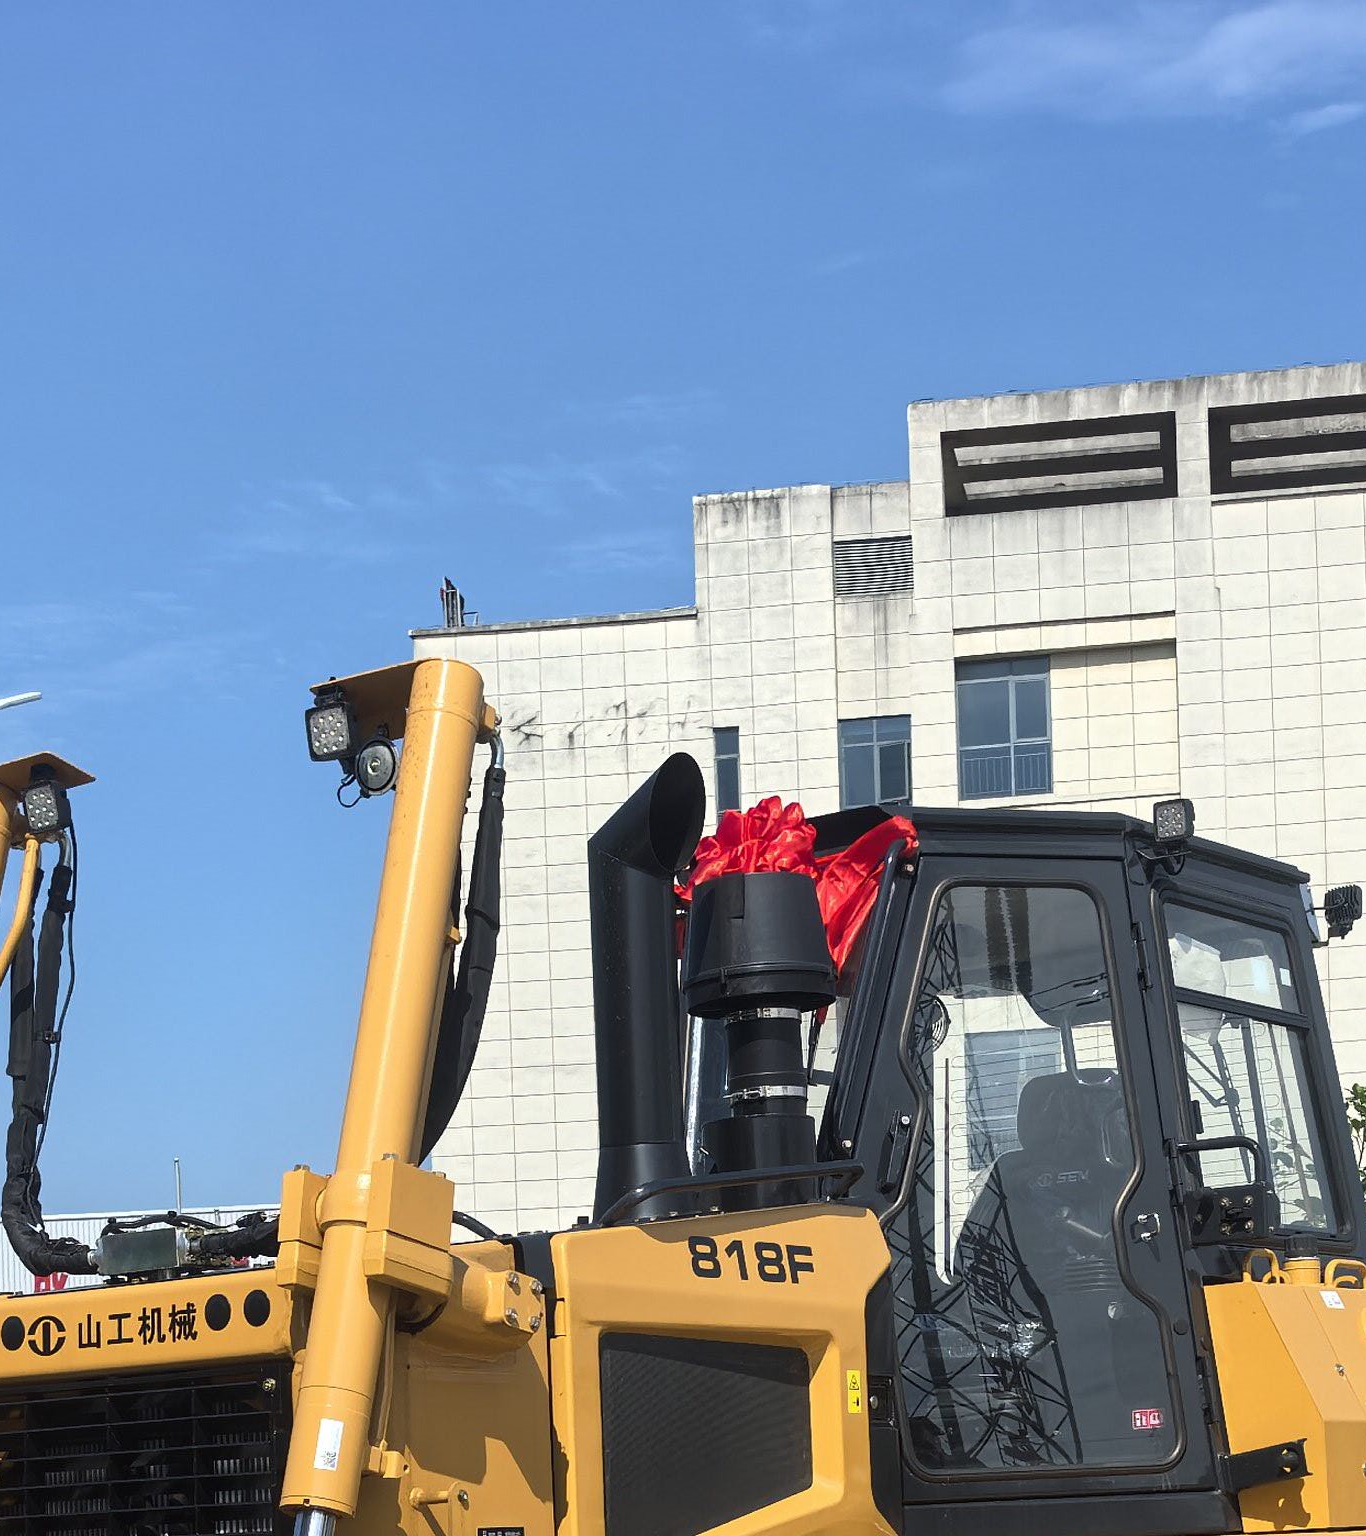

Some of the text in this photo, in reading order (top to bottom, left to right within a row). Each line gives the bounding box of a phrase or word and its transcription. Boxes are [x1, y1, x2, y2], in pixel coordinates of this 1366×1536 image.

[687, 1235, 815, 1284] 818F
[77, 1302, 199, 1350] 山工机械
